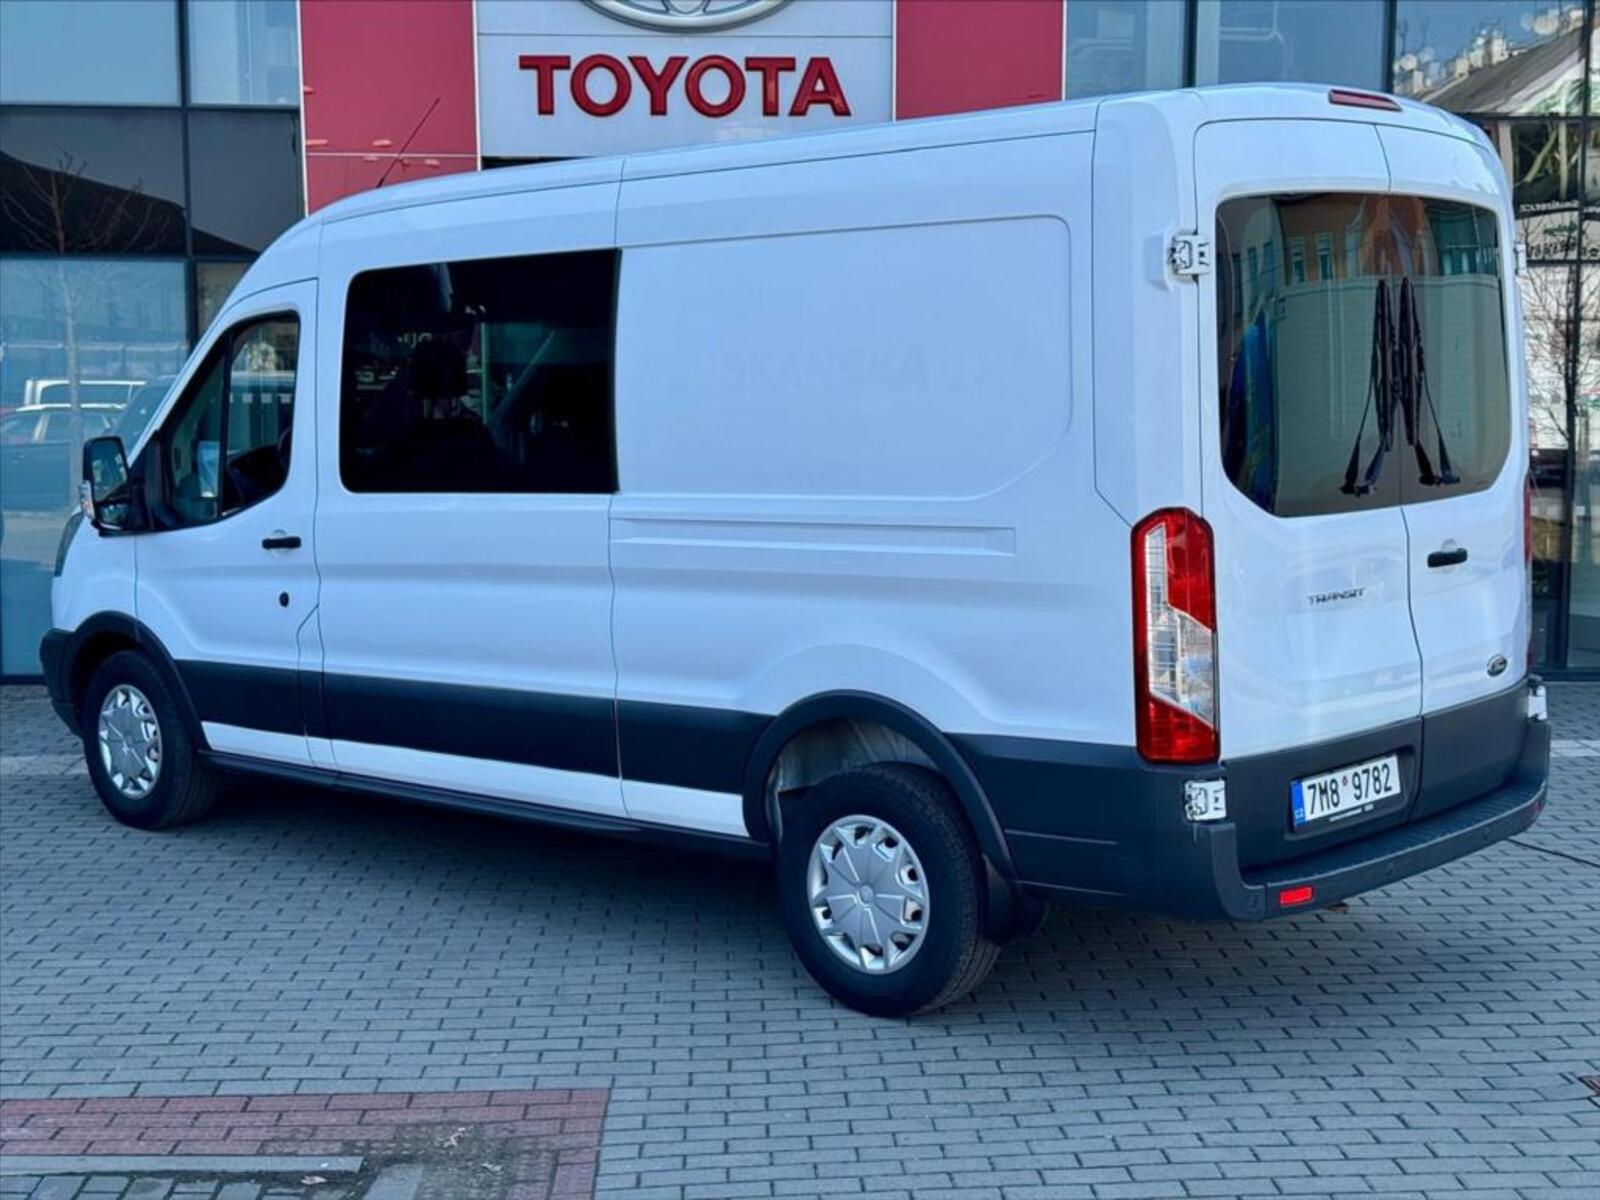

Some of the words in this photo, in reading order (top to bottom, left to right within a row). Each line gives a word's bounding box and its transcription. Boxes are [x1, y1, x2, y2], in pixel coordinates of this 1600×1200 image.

[518, 53, 852, 118] TOYOTA
[1307, 778, 1340, 815] 7M8
[1351, 763, 1393, 801] 9782
